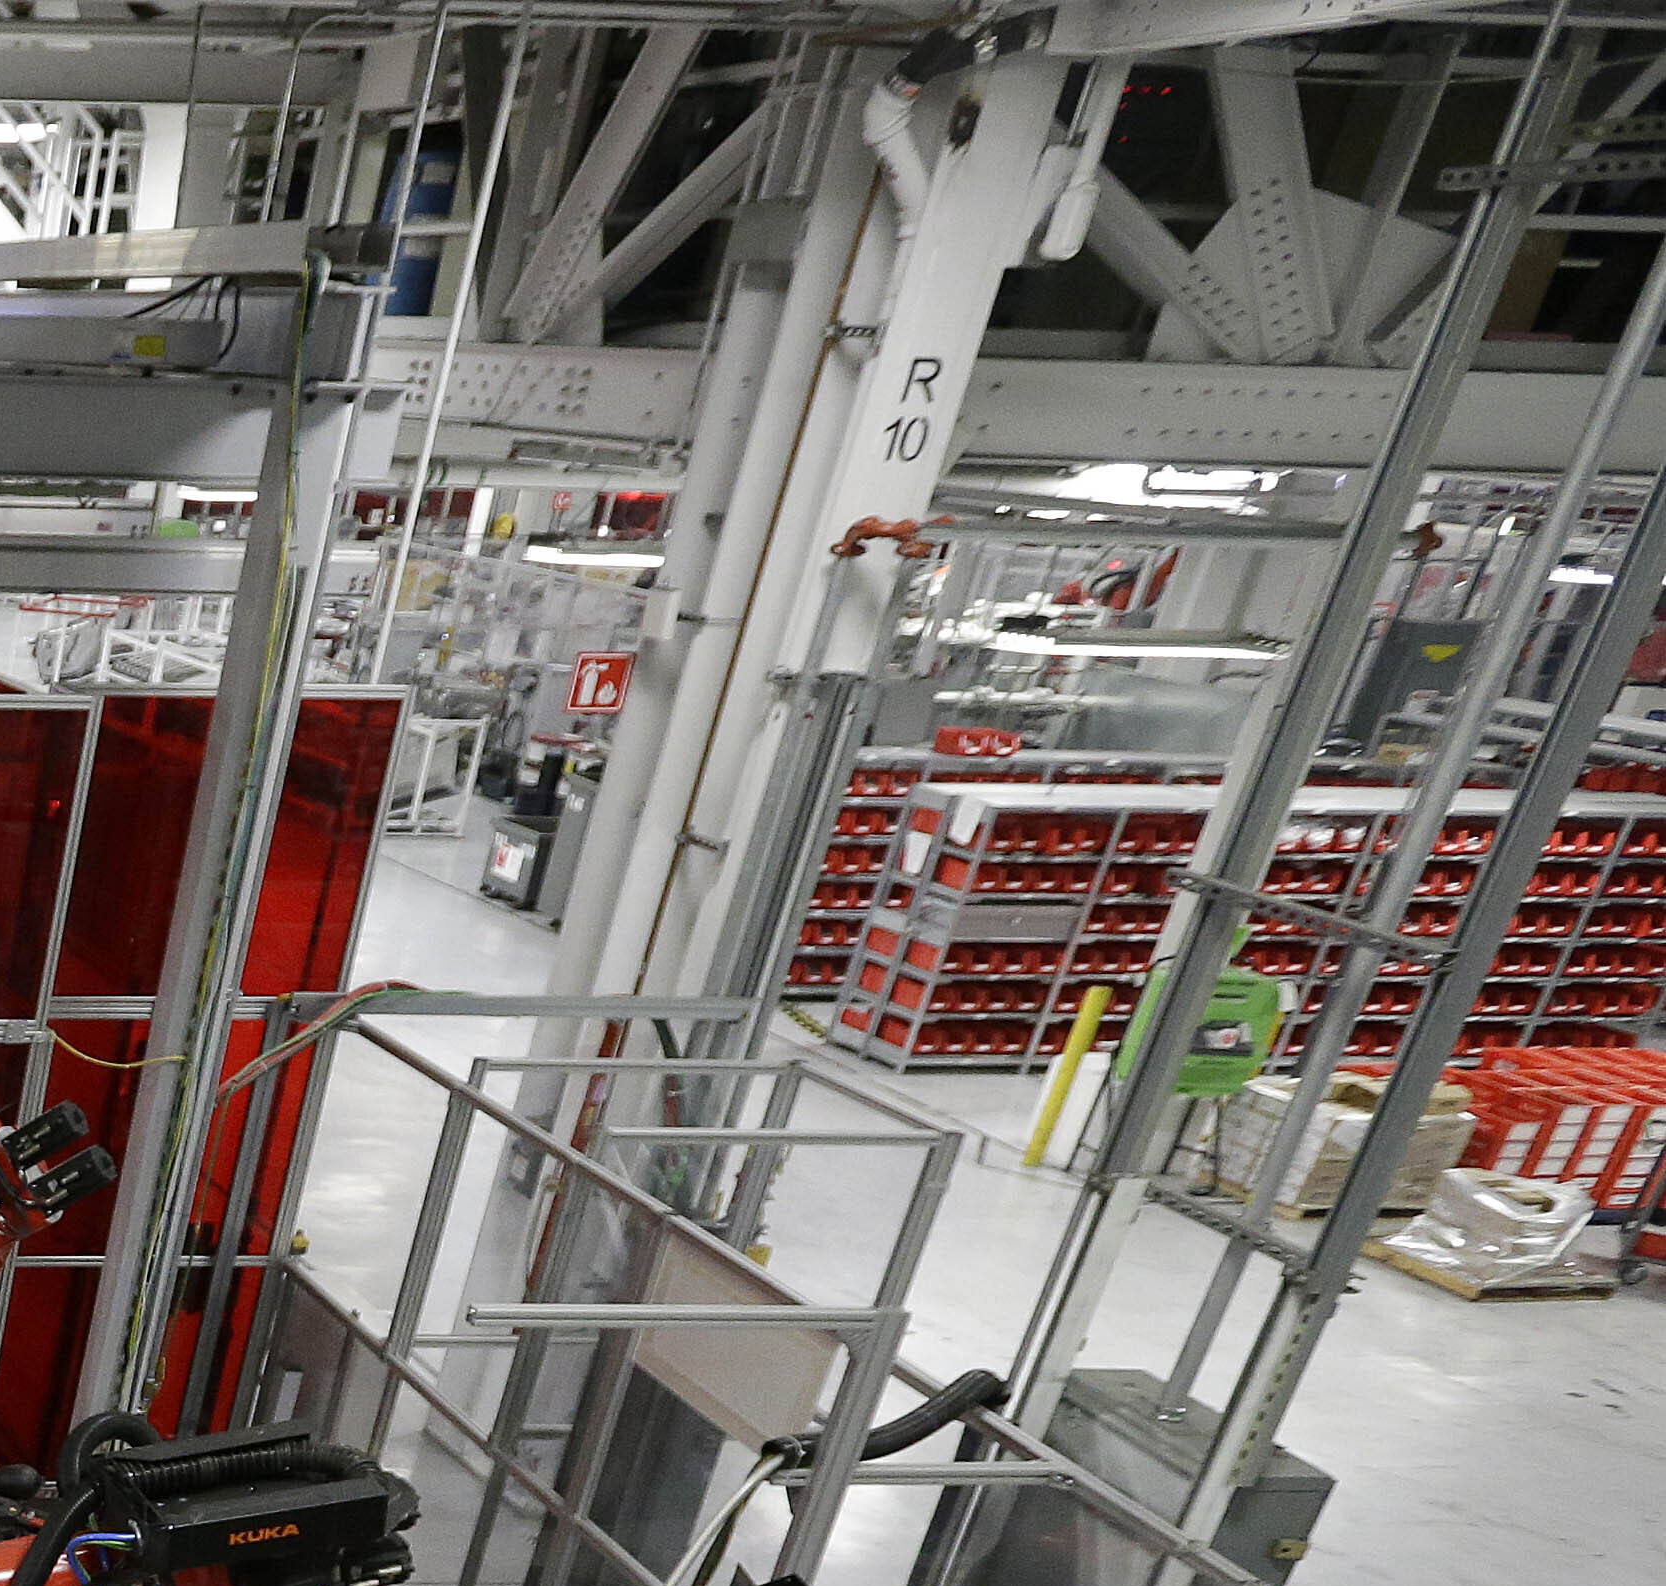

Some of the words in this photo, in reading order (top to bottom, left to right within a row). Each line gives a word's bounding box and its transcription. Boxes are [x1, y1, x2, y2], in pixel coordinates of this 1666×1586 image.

[899, 358, 940, 402] R
[884, 417, 928, 461] 10
[228, 1524, 300, 1545] KUKA
